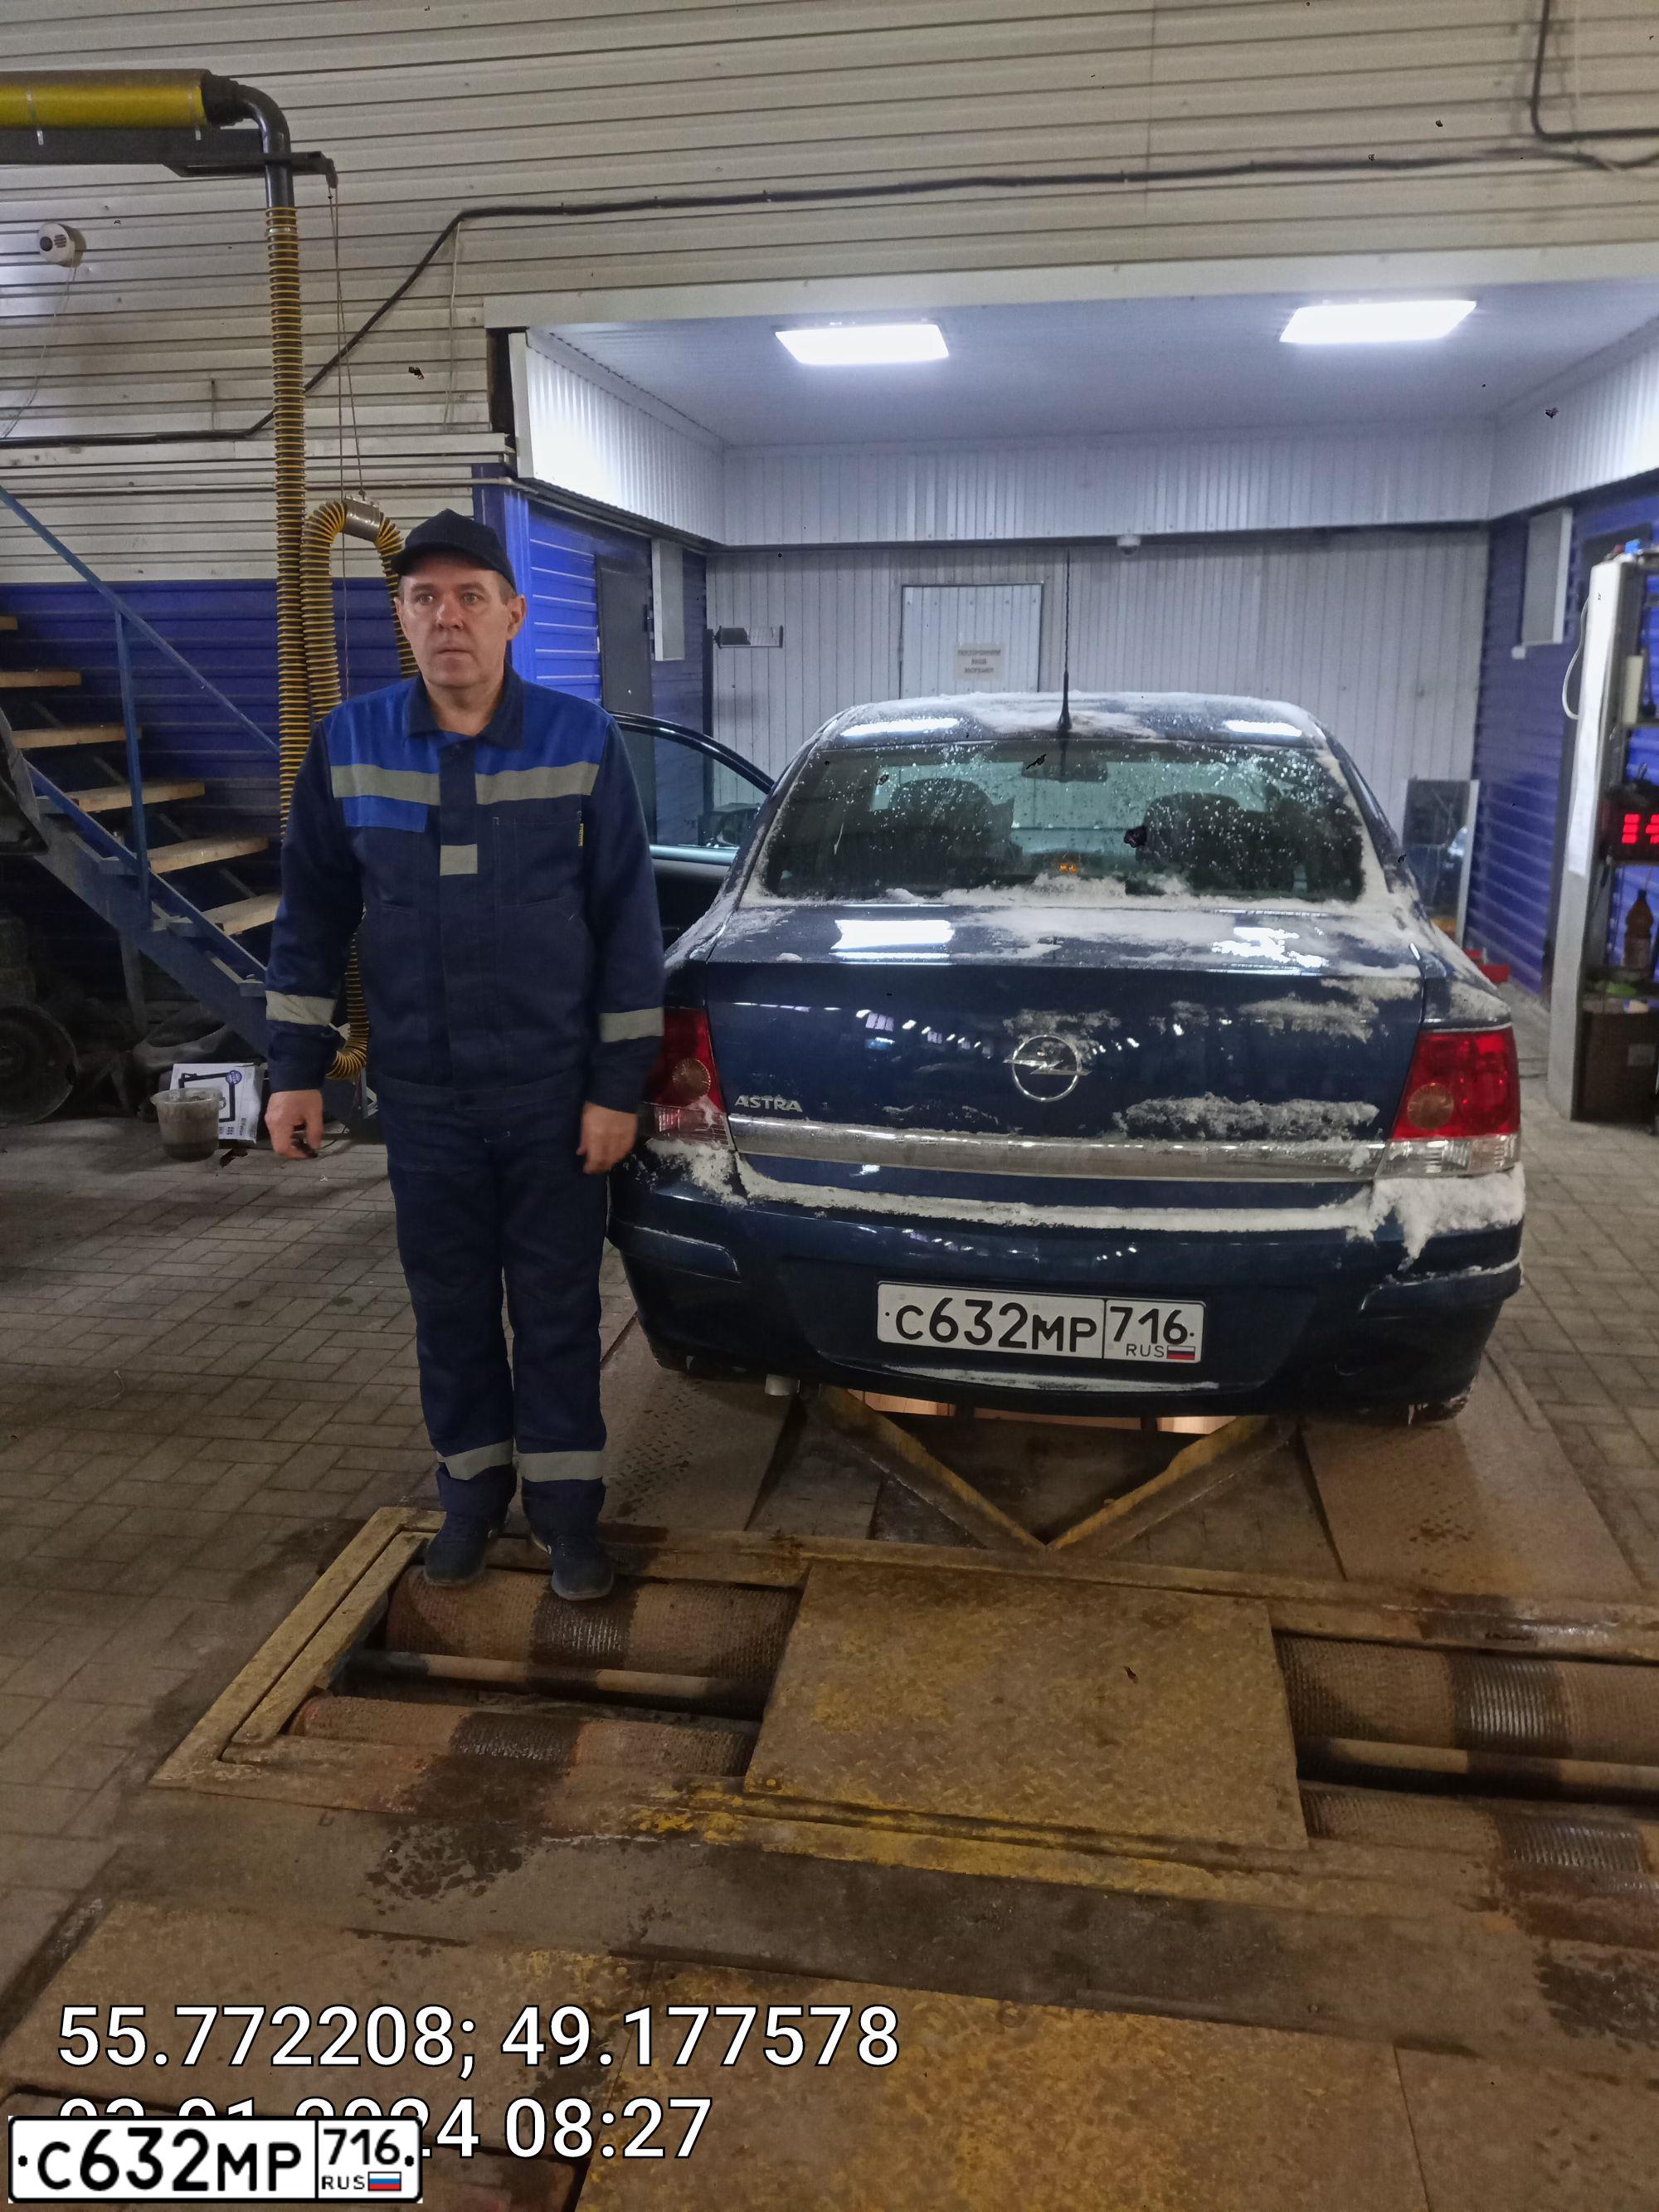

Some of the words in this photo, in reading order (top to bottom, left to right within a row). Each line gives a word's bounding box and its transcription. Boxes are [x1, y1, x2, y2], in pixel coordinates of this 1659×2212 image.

[734, 1094, 803, 1113] ASTRA
[1110, 1305, 1188, 1345] 716
[1126, 1343, 1165, 1358] RUS
